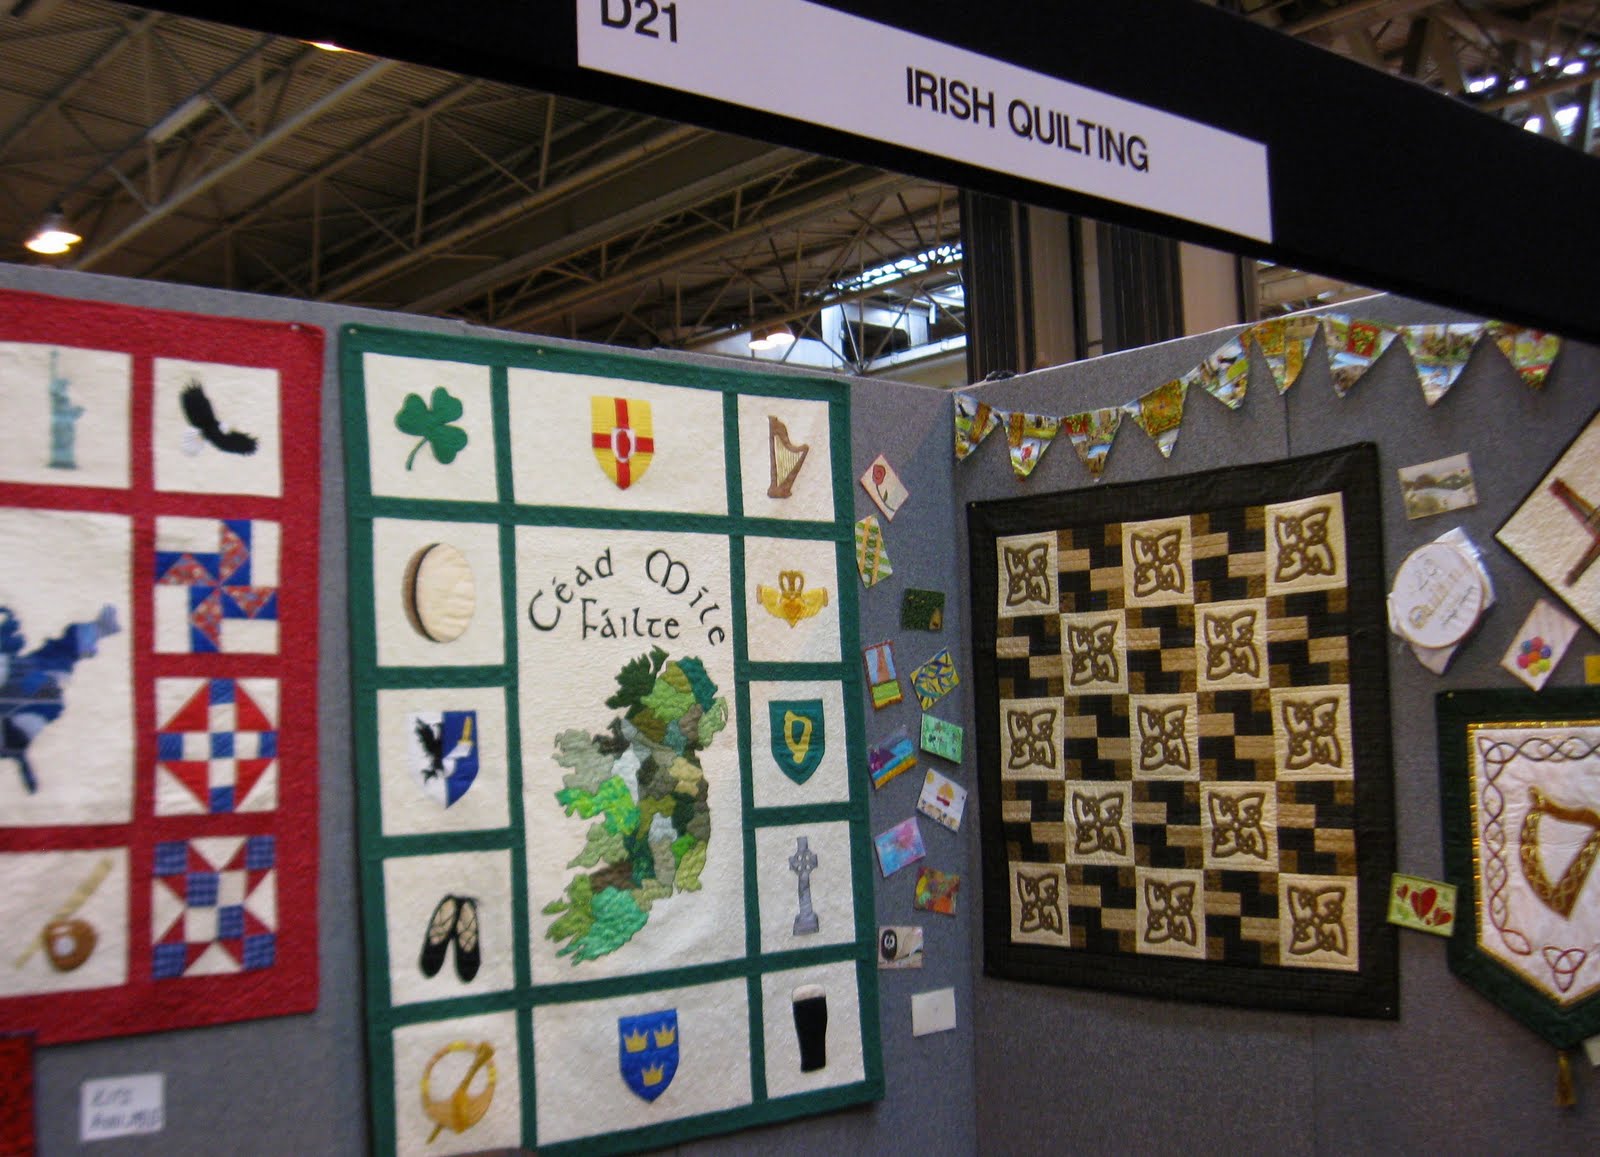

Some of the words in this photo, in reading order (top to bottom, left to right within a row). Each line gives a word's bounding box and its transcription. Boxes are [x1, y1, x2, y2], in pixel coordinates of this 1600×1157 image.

[600, 0, 677, 43] D21
[906, 67, 995, 128] IRISH
[1008, 99, 1149, 172] QUILTING
[528, 547, 614, 631] Céad
[580, 597, 680, 640] Fáilte
